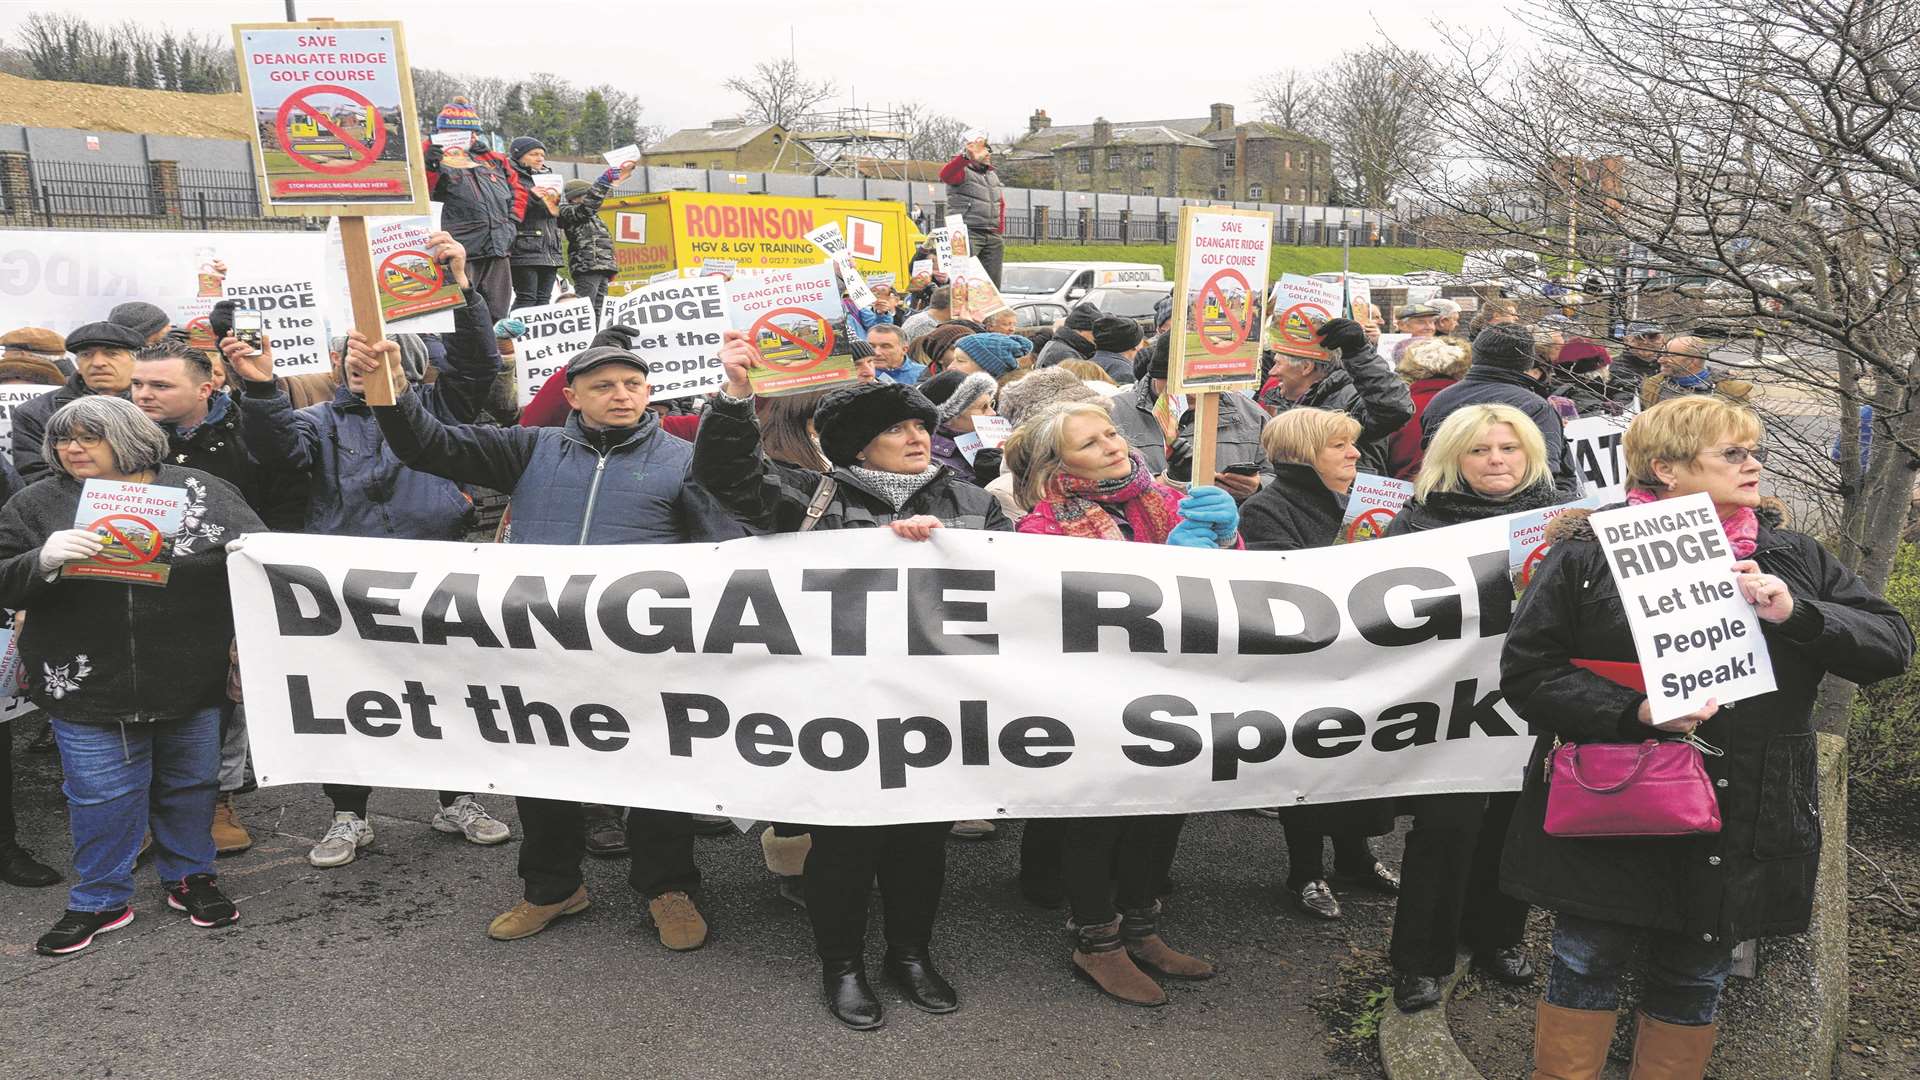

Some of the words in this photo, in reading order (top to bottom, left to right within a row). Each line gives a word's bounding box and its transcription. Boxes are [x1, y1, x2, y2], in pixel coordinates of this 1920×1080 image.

[297, 35, 337, 47] SAVE
[253, 53, 337, 65] DEANGATE
[339, 52, 387, 64] RIDGE
[270, 70, 311, 82] GOLF
[314, 70, 376, 81] COURSE
[381, 223, 402, 234] SAVE
[621, 215, 640, 240] L
[685, 204, 814, 240] ROBINSON
[1221, 221, 1242, 233] SAVE
[393, 236, 429, 250] COURSE
[854, 222, 875, 257] L
[1196, 236, 1240, 249] DEANGATE
[1241, 239, 1264, 251] RIDGE
[692, 242, 717, 253] HGV
[721, 242, 729, 253] &
[733, 242, 755, 253] LGV
[760, 242, 813, 254] TRAINING
[1201, 254, 1225, 265] GOLF
[1226, 254, 1256, 266] COURSE
[764, 272, 793, 285] SAVE
[227, 281, 313, 296] DEANGATE
[732, 286, 793, 303] DEANGATE
[795, 279, 832, 292] RIDGE
[228, 293, 316, 311] RIDGE
[618, 285, 720, 313] DEANGATE
[743, 300, 773, 312] GOLF
[776, 292, 824, 306] COURSE
[617, 299, 724, 326] RIDGE
[278, 317, 313, 329] the
[270, 335, 315, 351] ople
[675, 332, 721, 347] the
[525, 345, 553, 361] Let
[557, 341, 588, 354] the
[274, 352, 319, 368] eak!
[648, 355, 723, 374] eople
[649, 374, 723, 396] peak!
[121, 484, 149, 494] SAVE
[1356, 485, 1398, 499] DEANGATE
[1382, 480, 1402, 490] SAVE
[86, 491, 143, 504] DEANGATE
[145, 498, 178, 509] RIDGE
[1360, 496, 1383, 507] GOLF
[92, 503, 121, 512] GOLF
[123, 506, 167, 517] COURSE
[1604, 507, 1714, 545] DEANGATE
[1612, 528, 1727, 579] RIDGE
[1638, 587, 1687, 618] Let
[1690, 580, 1735, 606] the
[263, 563, 998, 656] DEANGATE
[1653, 617, 1747, 658] People
[1661, 652, 1757, 699] Speak!
[286, 674, 442, 740] Let
[465, 684, 631, 752] the
[660, 691, 1075, 789] People
